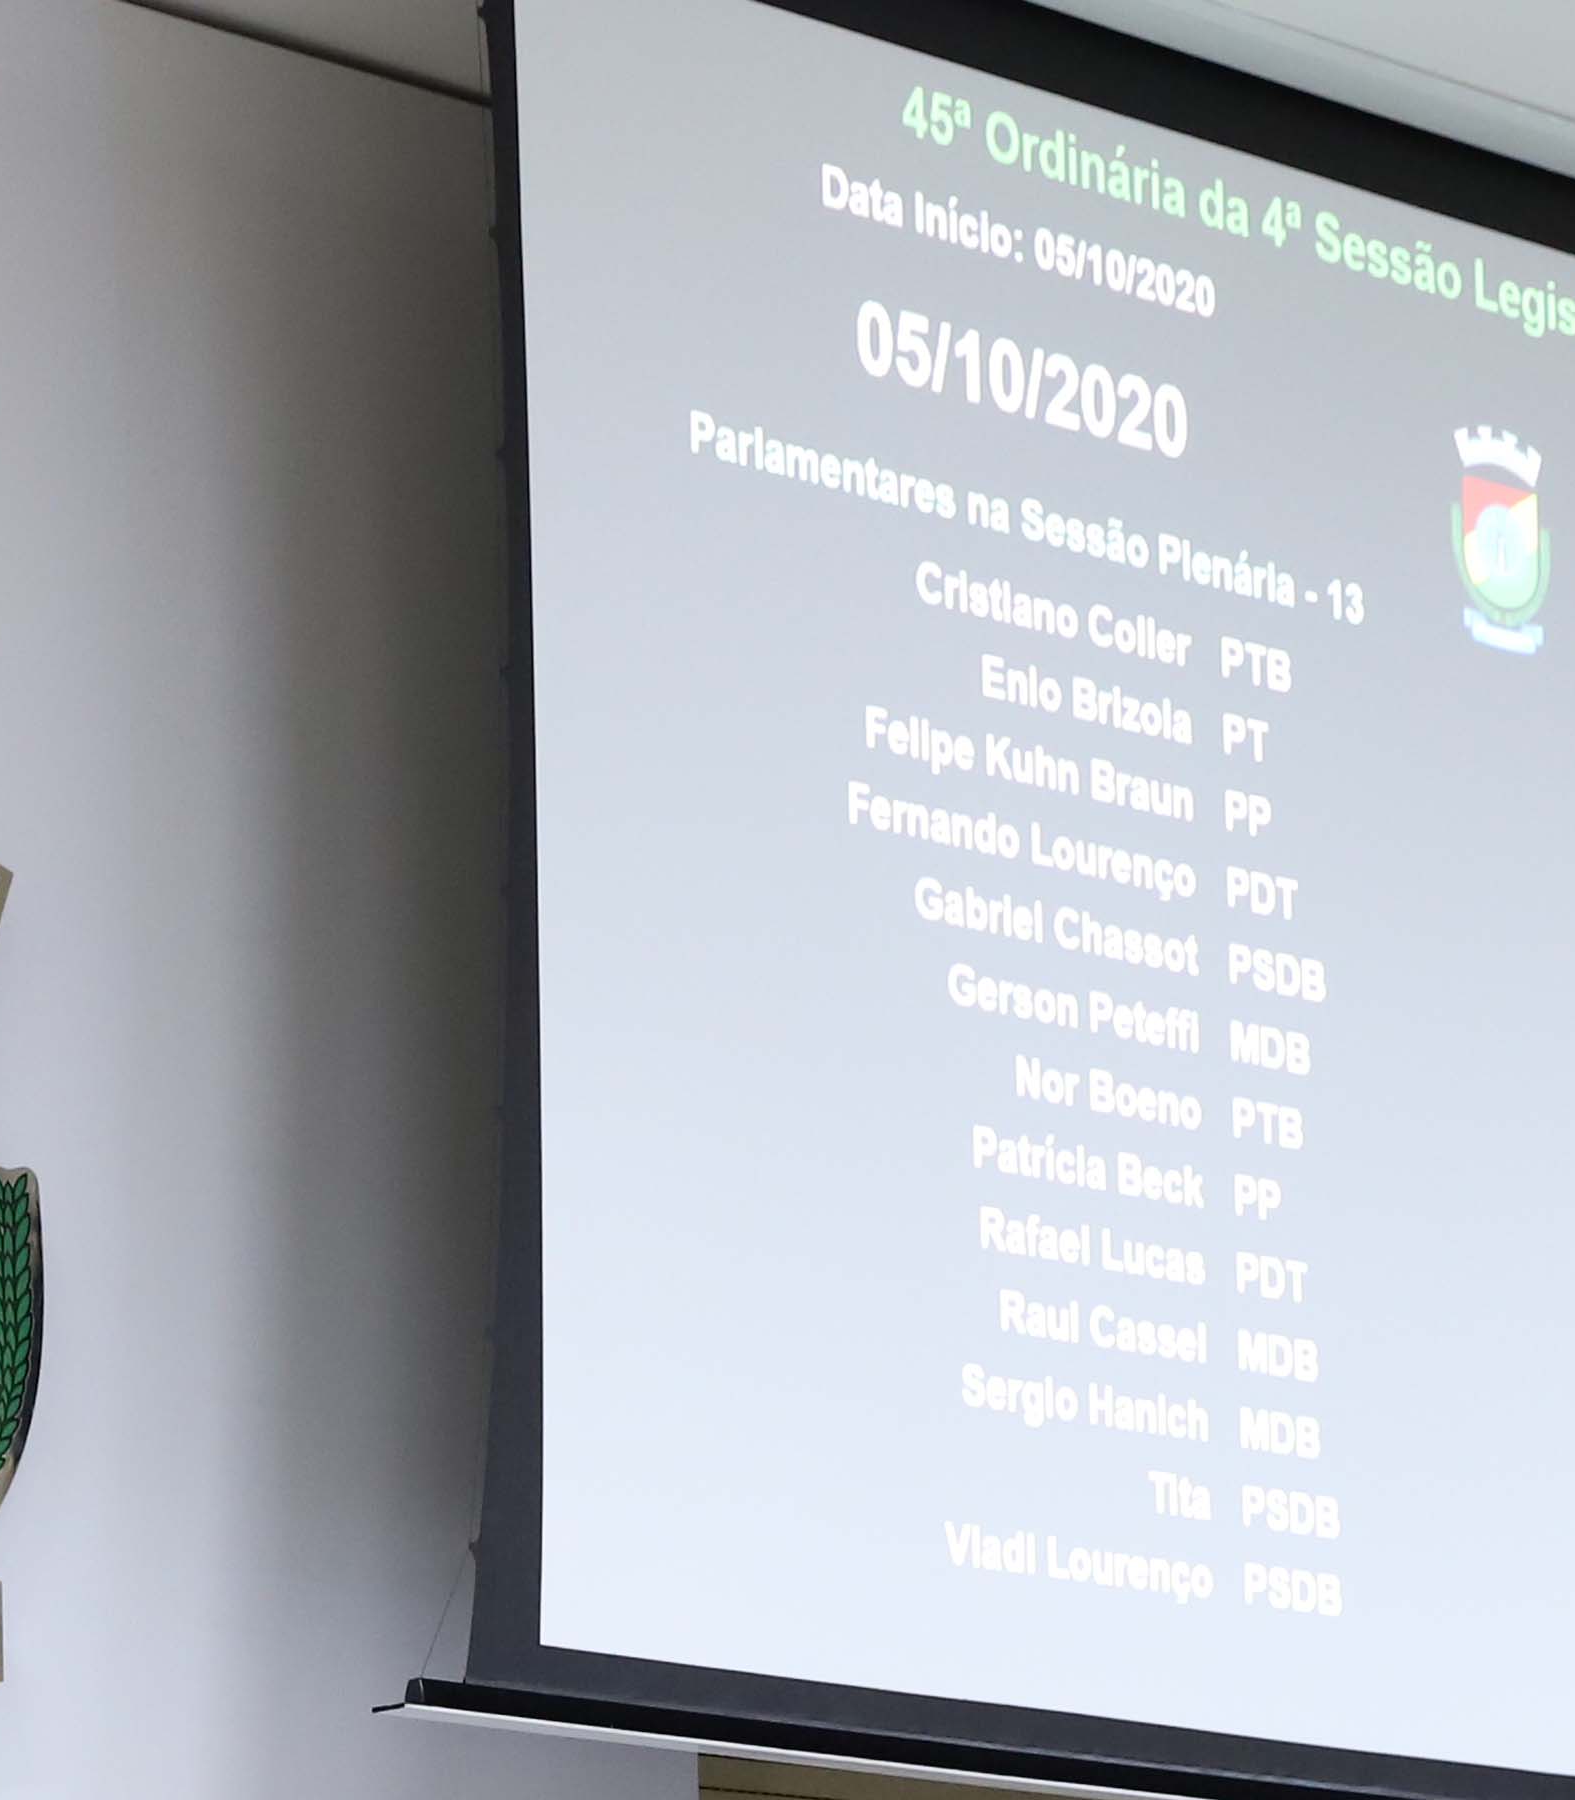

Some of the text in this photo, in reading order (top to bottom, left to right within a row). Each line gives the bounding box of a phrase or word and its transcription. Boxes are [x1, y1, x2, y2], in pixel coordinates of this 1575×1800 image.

[822, 164, 1216, 317] Data Início: 05/10/2020
[987, 111, 1184, 217] Ordinária
[1199, 177, 1249, 237] da
[1315, 210, 1462, 300] Sessão
[856, 300, 1188, 458] 05/10/2020
[690, 410, 956, 519] Parlamentares
[968, 481, 1009, 533] na
[1021, 498, 1148, 570] Sessão
[1159, 522, 1295, 608] Plenária
[1327, 578, 1365, 625] 13
[915, 561, 1192, 667] Cristiano Coller
[981, 654, 1193, 744] Enio Brizola
[1221, 636, 1292, 693] PTB
[864, 705, 1194, 822] Felipe Kuhn Braun
[1223, 713, 1269, 763] PT
[848, 780, 1196, 901] Fernando Lourenço
[1225, 790, 1272, 837] PP
[914, 876, 1200, 976] Gabriel Chassot
[1226, 866, 1298, 920] PDT
[947, 963, 1200, 1054] Gerson Peteffi
[1228, 943, 1327, 1002] PSDB
[1230, 1019, 1312, 1076] MDB
[1015, 1054, 1202, 1130] Nor Boeno
[1232, 1097, 1304, 1150] PTB
[972, 1125, 1205, 1209] Patrícia Beck
[1234, 1173, 1282, 1221] PP
[979, 1206, 1206, 1285] Rafael Lucas
[1236, 1251, 1308, 1303] PDT
[999, 1289, 1207, 1364] Raul Cassel
[1237, 1329, 1319, 1383] MDB
[961, 1362, 1210, 1443] Sergio Hanich
[1239, 1405, 1321, 1459] MDB
[1148, 1470, 1212, 1521] Tita
[1241, 1484, 1341, 1540] PSDB
[944, 1520, 1214, 1605] Vladi Lourenço
[1243, 1561, 1343, 1617] PSDB
